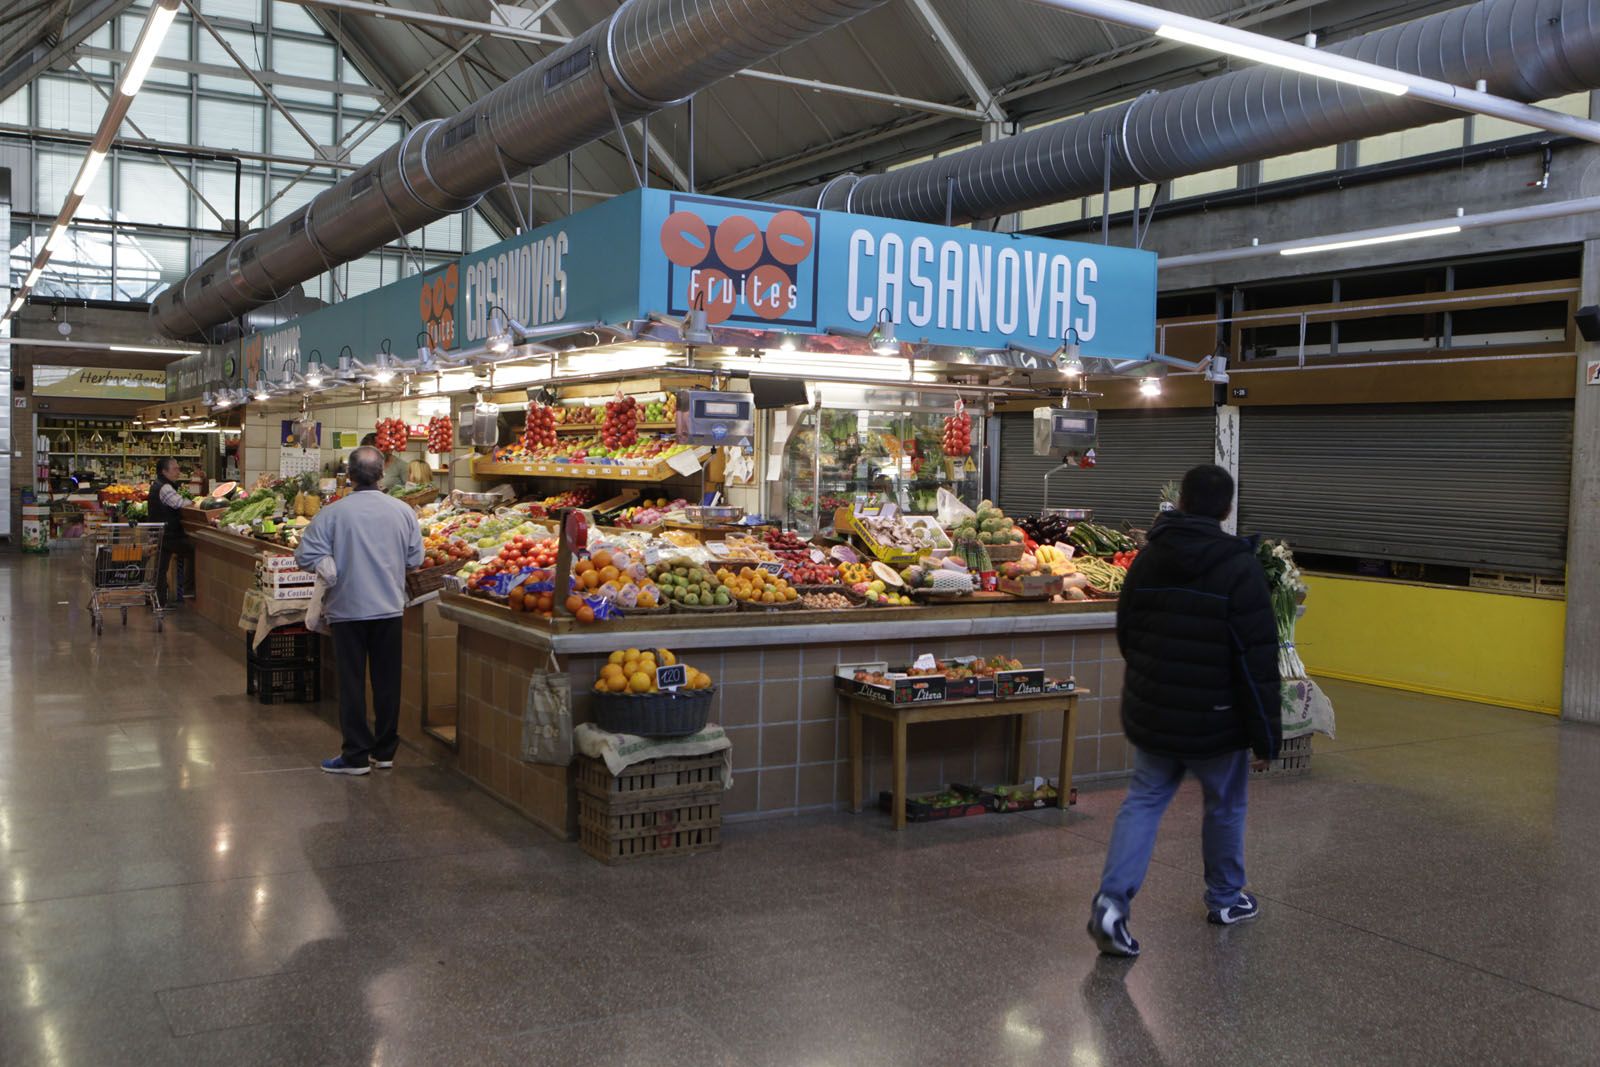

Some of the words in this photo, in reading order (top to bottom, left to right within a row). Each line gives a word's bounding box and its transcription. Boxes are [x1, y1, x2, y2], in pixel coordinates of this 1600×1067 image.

[465, 230, 569, 343] CASANOVAS
[690, 268, 798, 311] Fruites
[847, 228, 1098, 342] CASANOVAS
[280, 558, 297, 566] Cost
[913, 688, 942, 701] Litera
[1014, 684, 1041, 695] Litera
